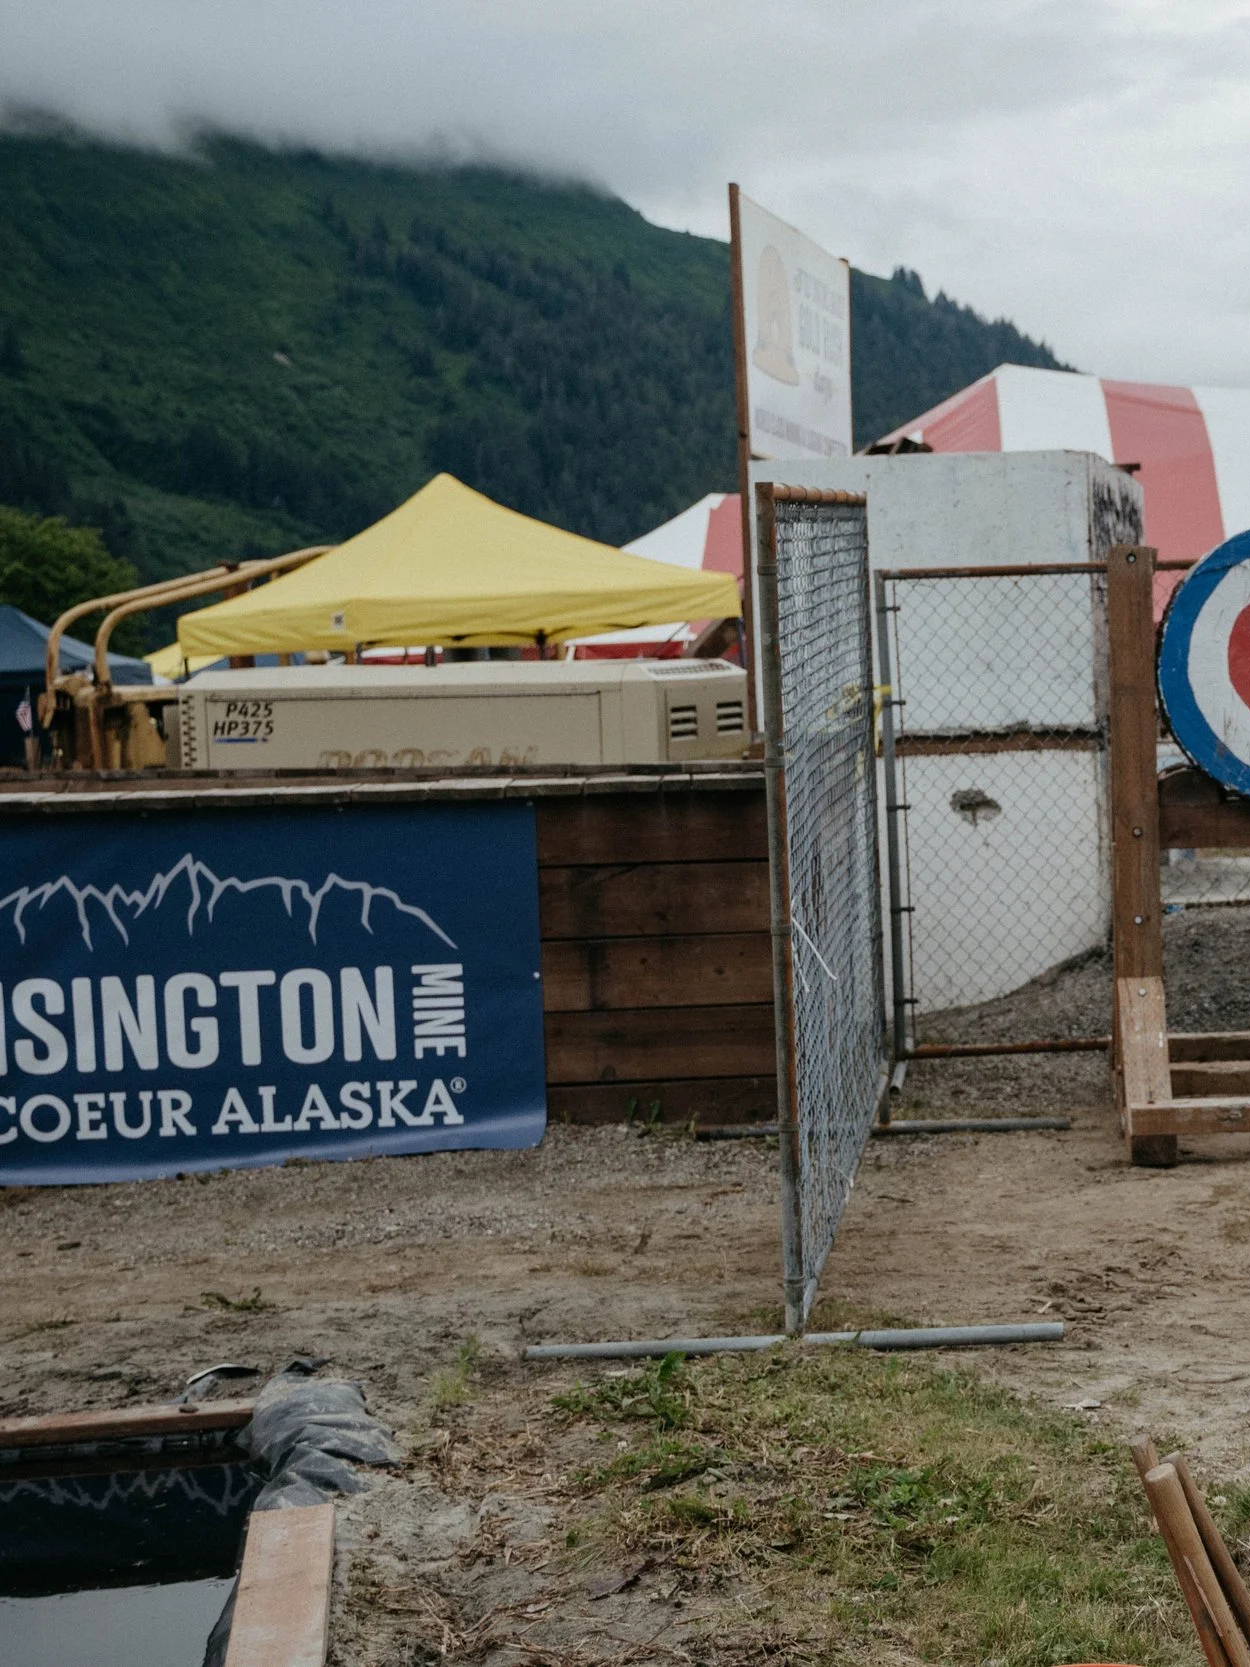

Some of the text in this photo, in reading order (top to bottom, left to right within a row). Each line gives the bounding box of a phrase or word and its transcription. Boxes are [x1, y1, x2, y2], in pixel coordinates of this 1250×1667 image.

[226, 702, 273, 718] P425
[213, 720, 274, 736] HP375
[411, 963, 467, 1060] MINE
